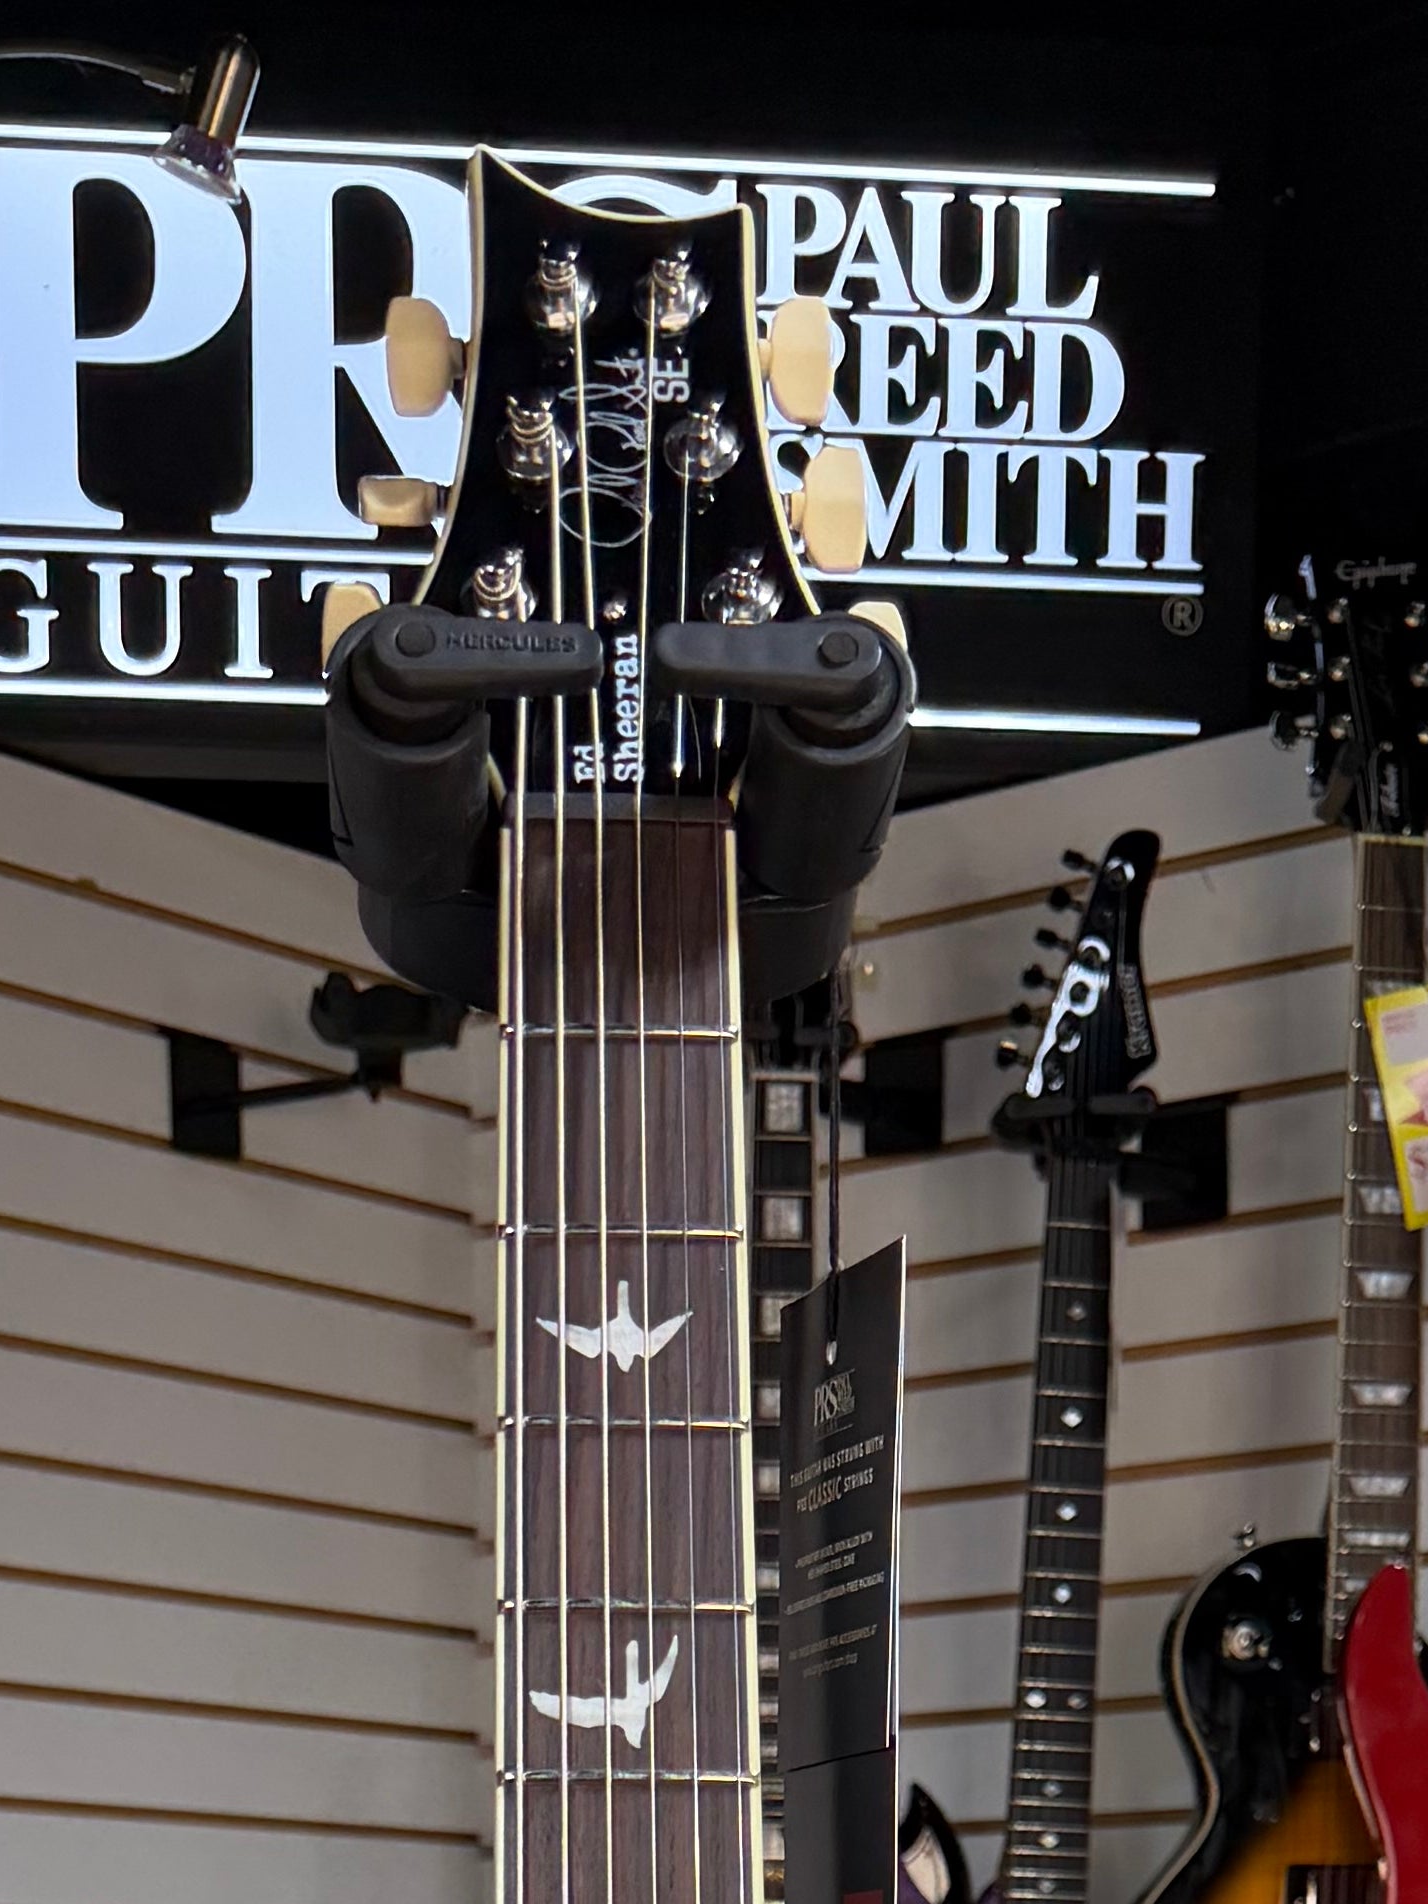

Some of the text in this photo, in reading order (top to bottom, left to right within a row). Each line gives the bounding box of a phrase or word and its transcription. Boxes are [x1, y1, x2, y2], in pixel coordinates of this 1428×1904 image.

[755, 184, 1099, 319] PAUL
[652, 357, 690, 403] SE
[446, 633, 578, 652] HERCULES
[612, 632, 645, 783] Sheeran
[574, 742, 606, 784] Ed
[808, 1475, 842, 1512] CLASSIC
